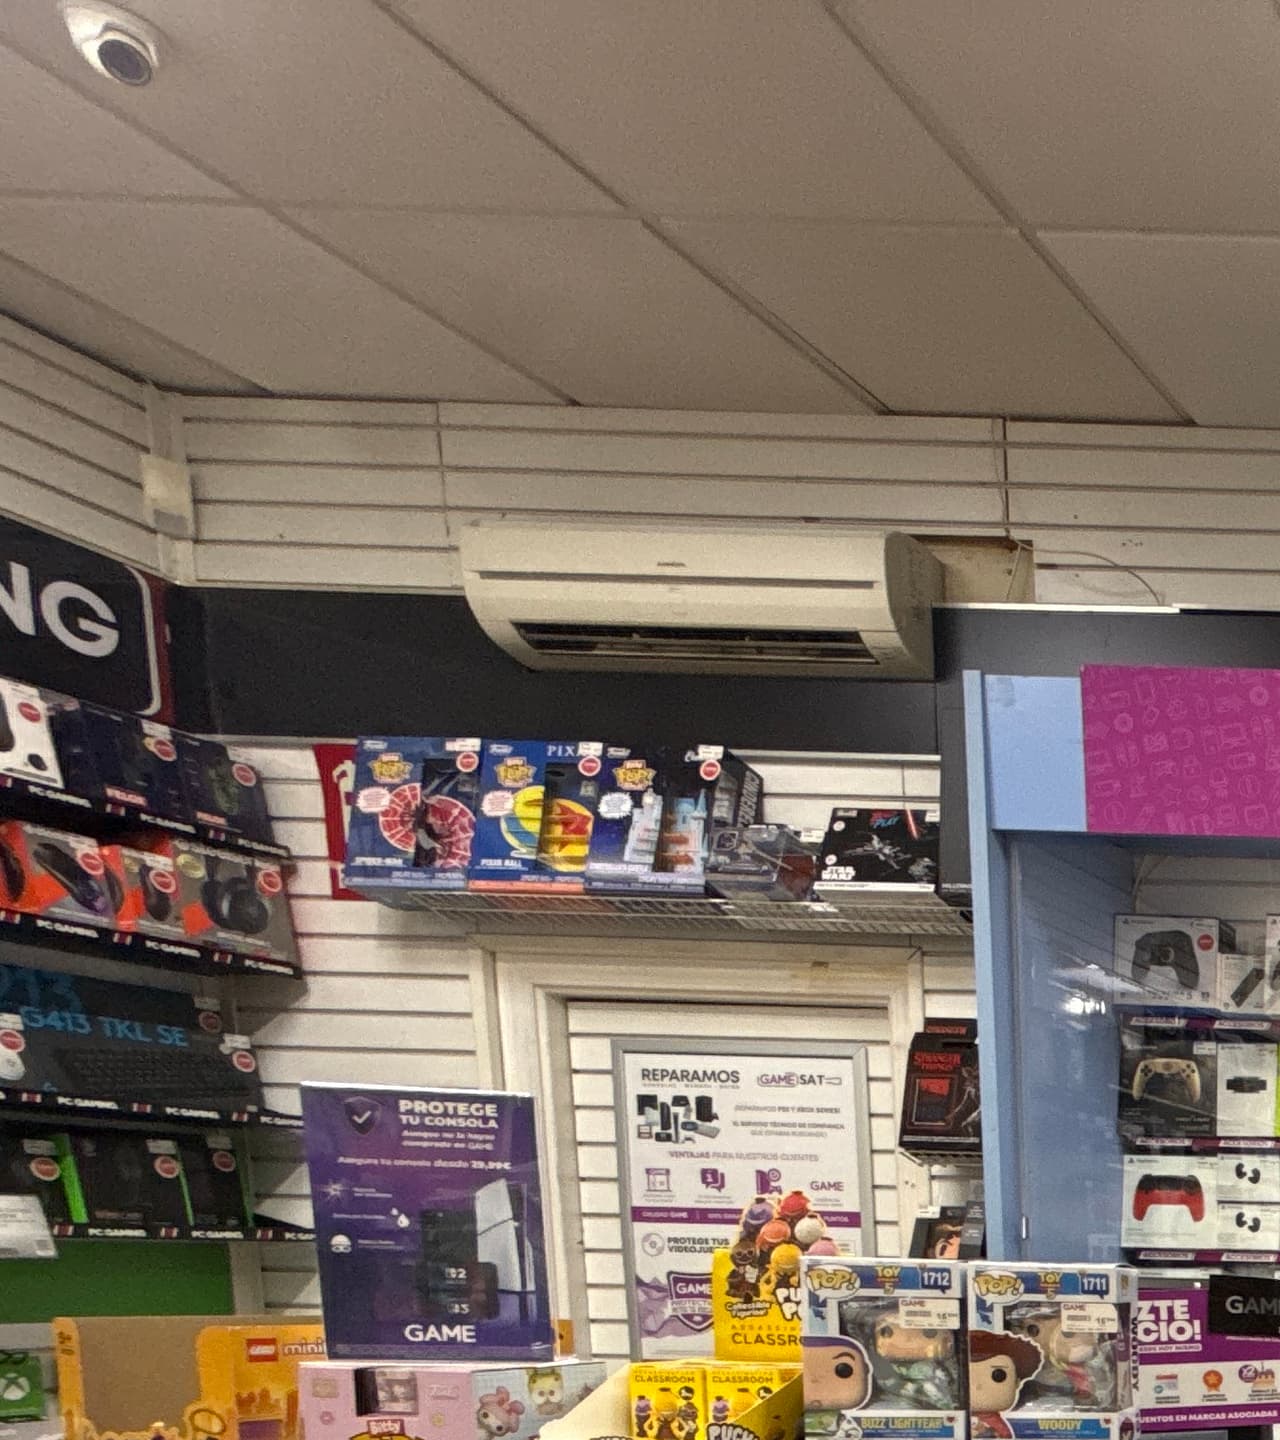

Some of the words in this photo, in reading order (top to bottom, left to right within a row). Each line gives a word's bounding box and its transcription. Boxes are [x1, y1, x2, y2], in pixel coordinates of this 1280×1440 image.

[642, 1069, 739, 1083] REPARAMOS
[759, 1074, 796, 1085] GAME
[800, 1074, 824, 1085] SAT
[399, 1100, 497, 1117] PROTEGE
[401, 1116, 420, 1125] TU
[425, 1117, 498, 1128] CONSOLA
[810, 1182, 843, 1190] GAME
[810, 1270, 856, 1288] POP!
[877, 1267, 900, 1276] TOY
[923, 1272, 949, 1286] 1712
[975, 1275, 1021, 1296] POP!
[1083, 1277, 1108, 1291] 1711
[405, 1325, 476, 1343] GAME
